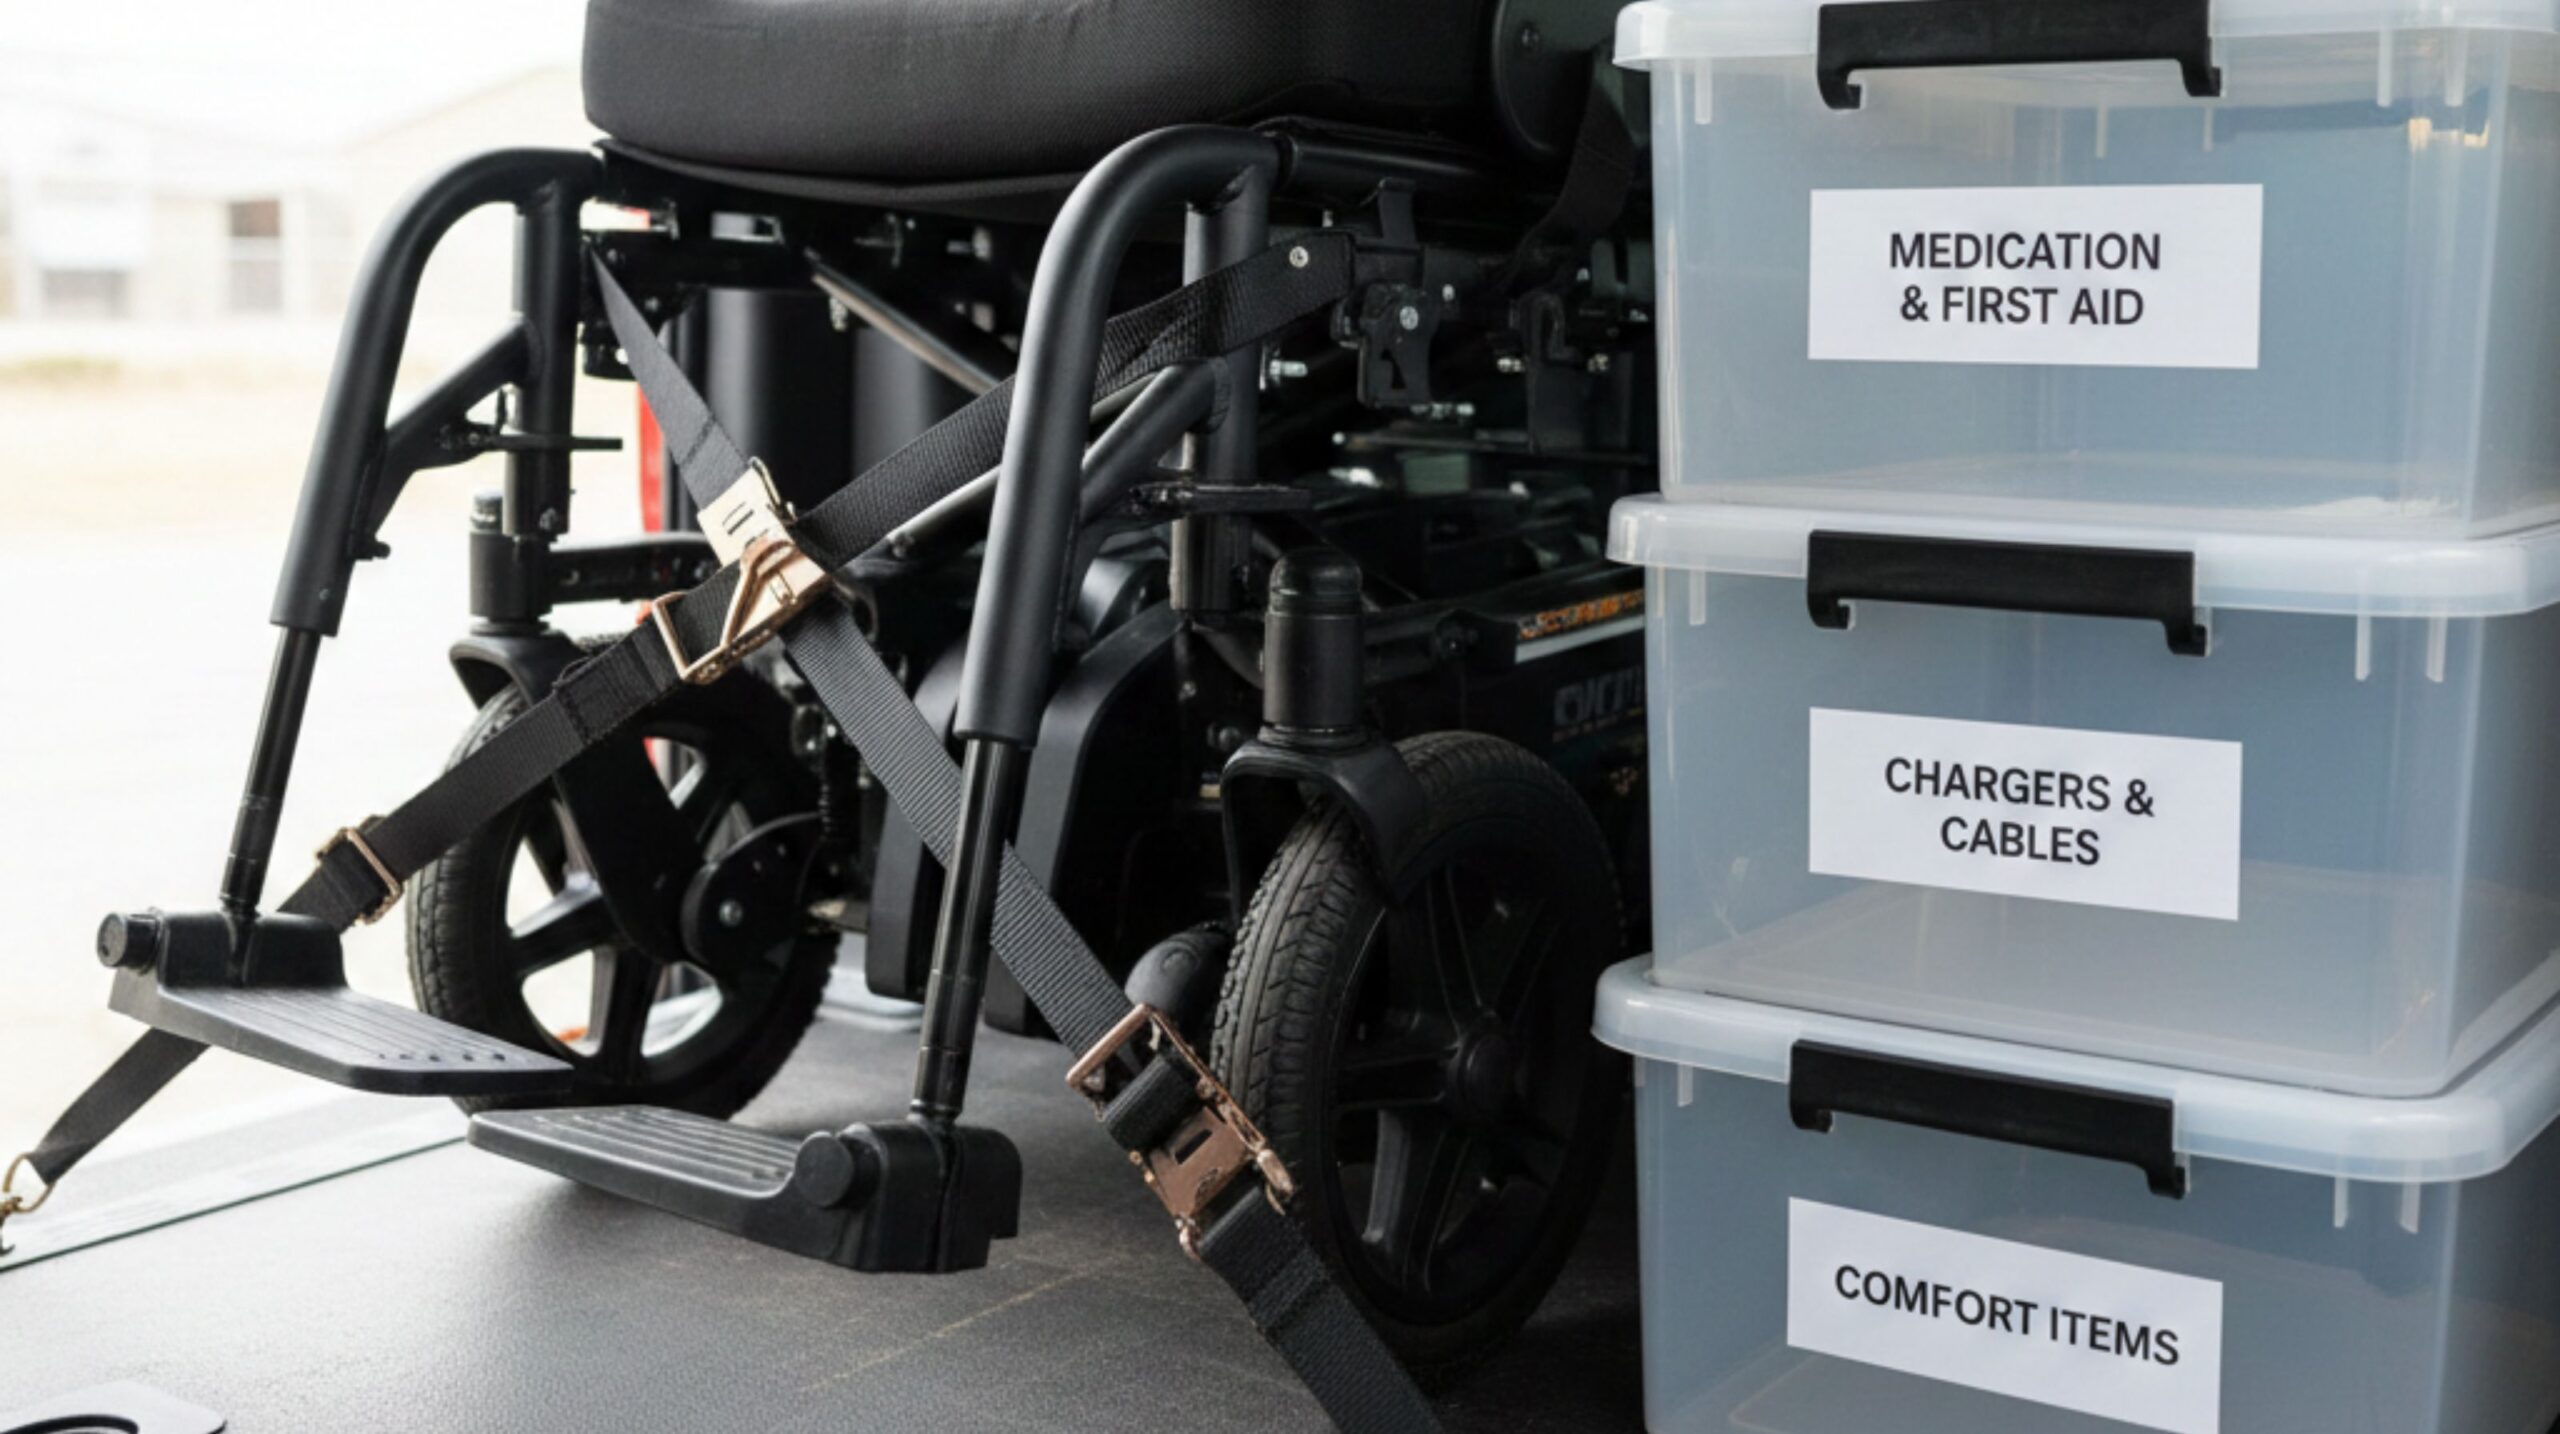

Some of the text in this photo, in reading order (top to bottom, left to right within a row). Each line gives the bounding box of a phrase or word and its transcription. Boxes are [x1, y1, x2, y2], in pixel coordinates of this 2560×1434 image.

[1891, 233, 2160, 270] MEDICATION
[1901, 285, 2143, 325] & FIRST AID
[1885, 758, 2153, 817] CHARGERS &
[1941, 816, 2100, 866] CABLES
[1835, 1265, 2179, 1365] COMFORT ITEMS
